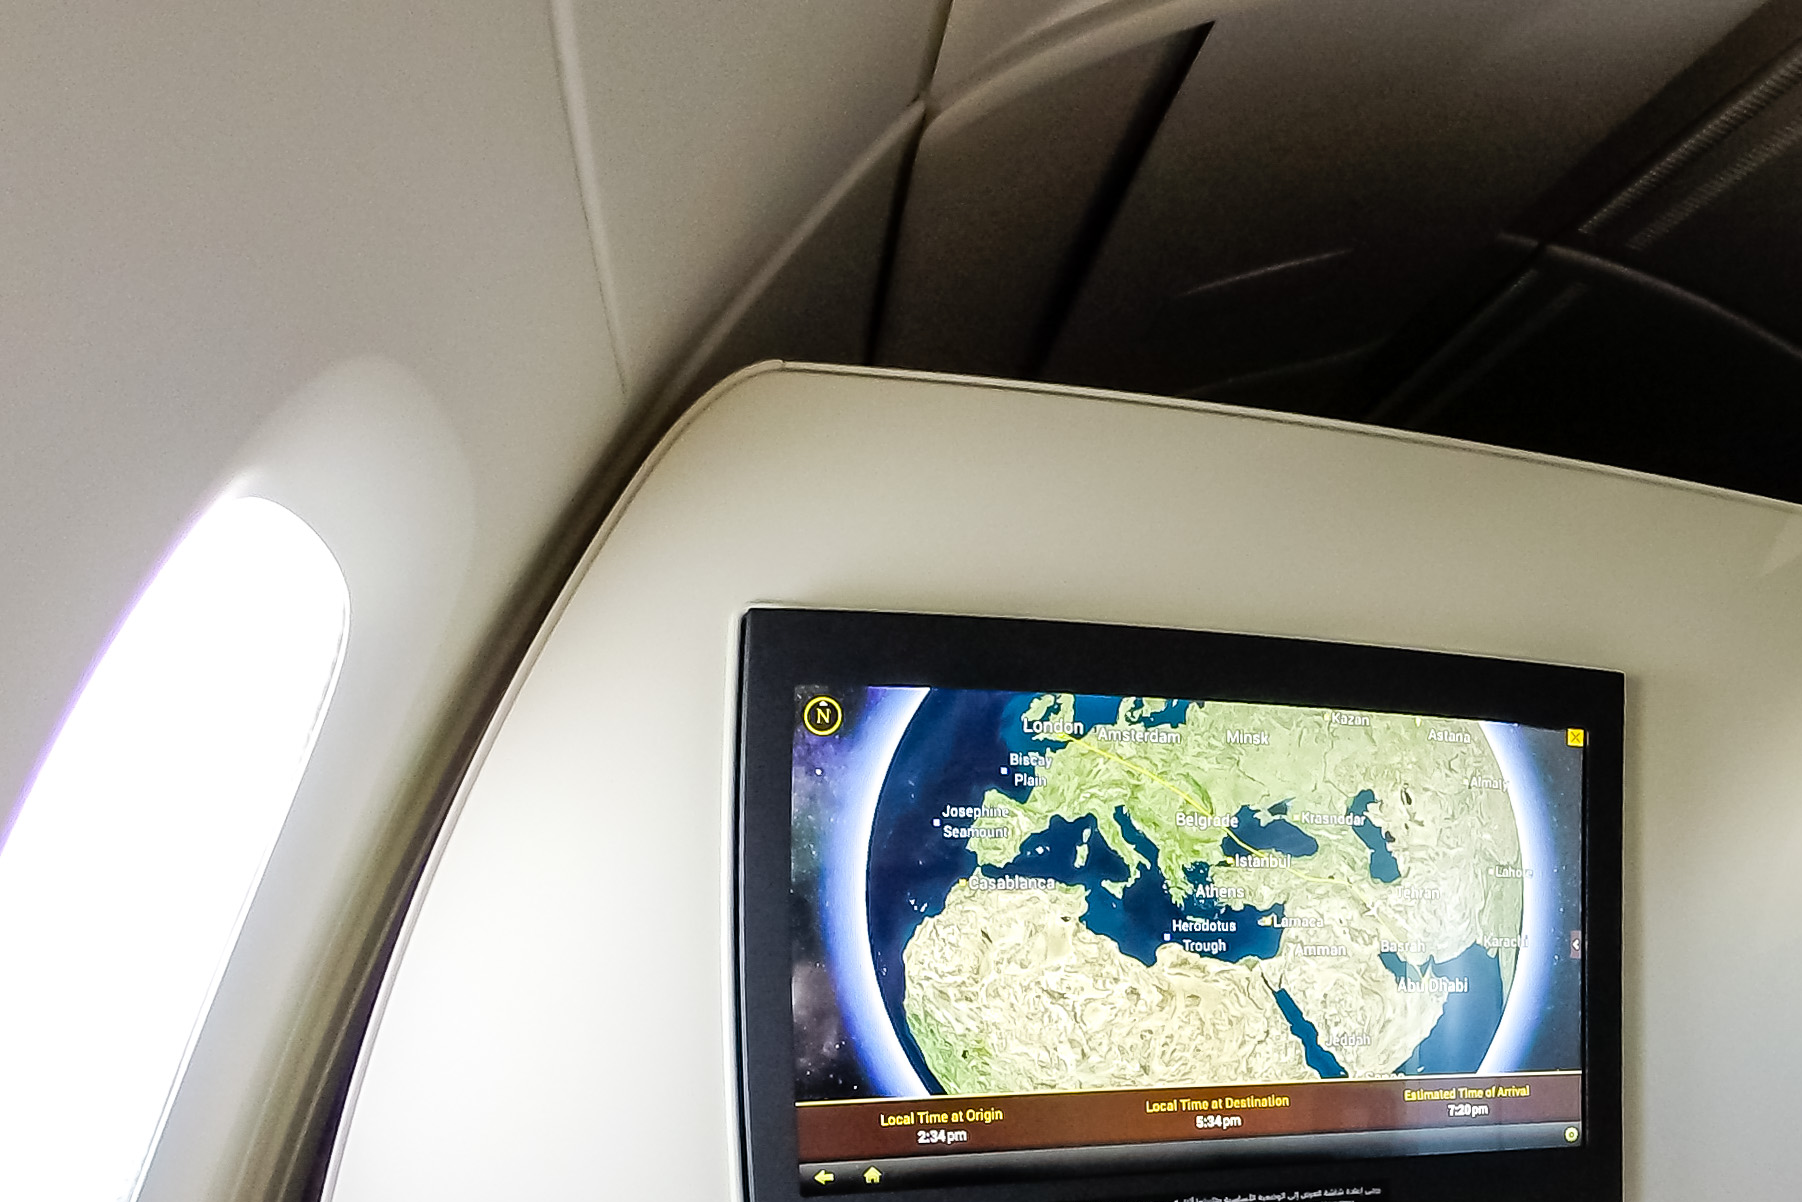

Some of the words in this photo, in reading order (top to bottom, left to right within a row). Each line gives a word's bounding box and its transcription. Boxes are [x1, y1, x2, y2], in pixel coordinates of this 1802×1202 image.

[1023, 718, 1084, 736] London
[1331, 712, 1370, 727] Kazan
[1097, 729, 1181, 745] Amsterdam
[1226, 730, 1269, 745] Minsk
[1428, 729, 1471, 744] Astana
[1009, 753, 1052, 769] Biscay
[1014, 773, 1048, 787] Plain
[942, 804, 1009, 820] Josephine
[1301, 811, 1366, 826] Krasnodar
[1175, 812, 1239, 829] Belgrade
[943, 825, 1008, 838] Seamount
[1235, 854, 1291, 868] Istanbul
[968, 874, 1055, 890] Casablanca
[1195, 884, 1245, 899] Athens
[1396, 886, 1441, 900] Tehran
[1172, 919, 1237, 933] Herodotus
[1182, 939, 1227, 954] Trough
[1295, 943, 1347, 956] Amman
[1380, 940, 1426, 953] Basrah
[1397, 979, 1424, 993] Abu
[1429, 978, 1469, 993] Dhabi
[1326, 1034, 1371, 1047] Jeddah
[1404, 1088, 1456, 1101] Estimated
[1458, 1086, 1483, 1099] Time
[1485, 1086, 1497, 1098] of
[1497, 1085, 1530, 1097] Arrival
[1146, 1099, 1178, 1113] Local
[1180, 1097, 1208, 1111] Time
[1211, 1098, 1223, 1110] at
[1225, 1094, 1290, 1109] Destination
[880, 1111, 915, 1127] Local
[917, 1110, 949, 1124] Time
[951, 1110, 964, 1123] at
[966, 1107, 1004, 1124] Origin
